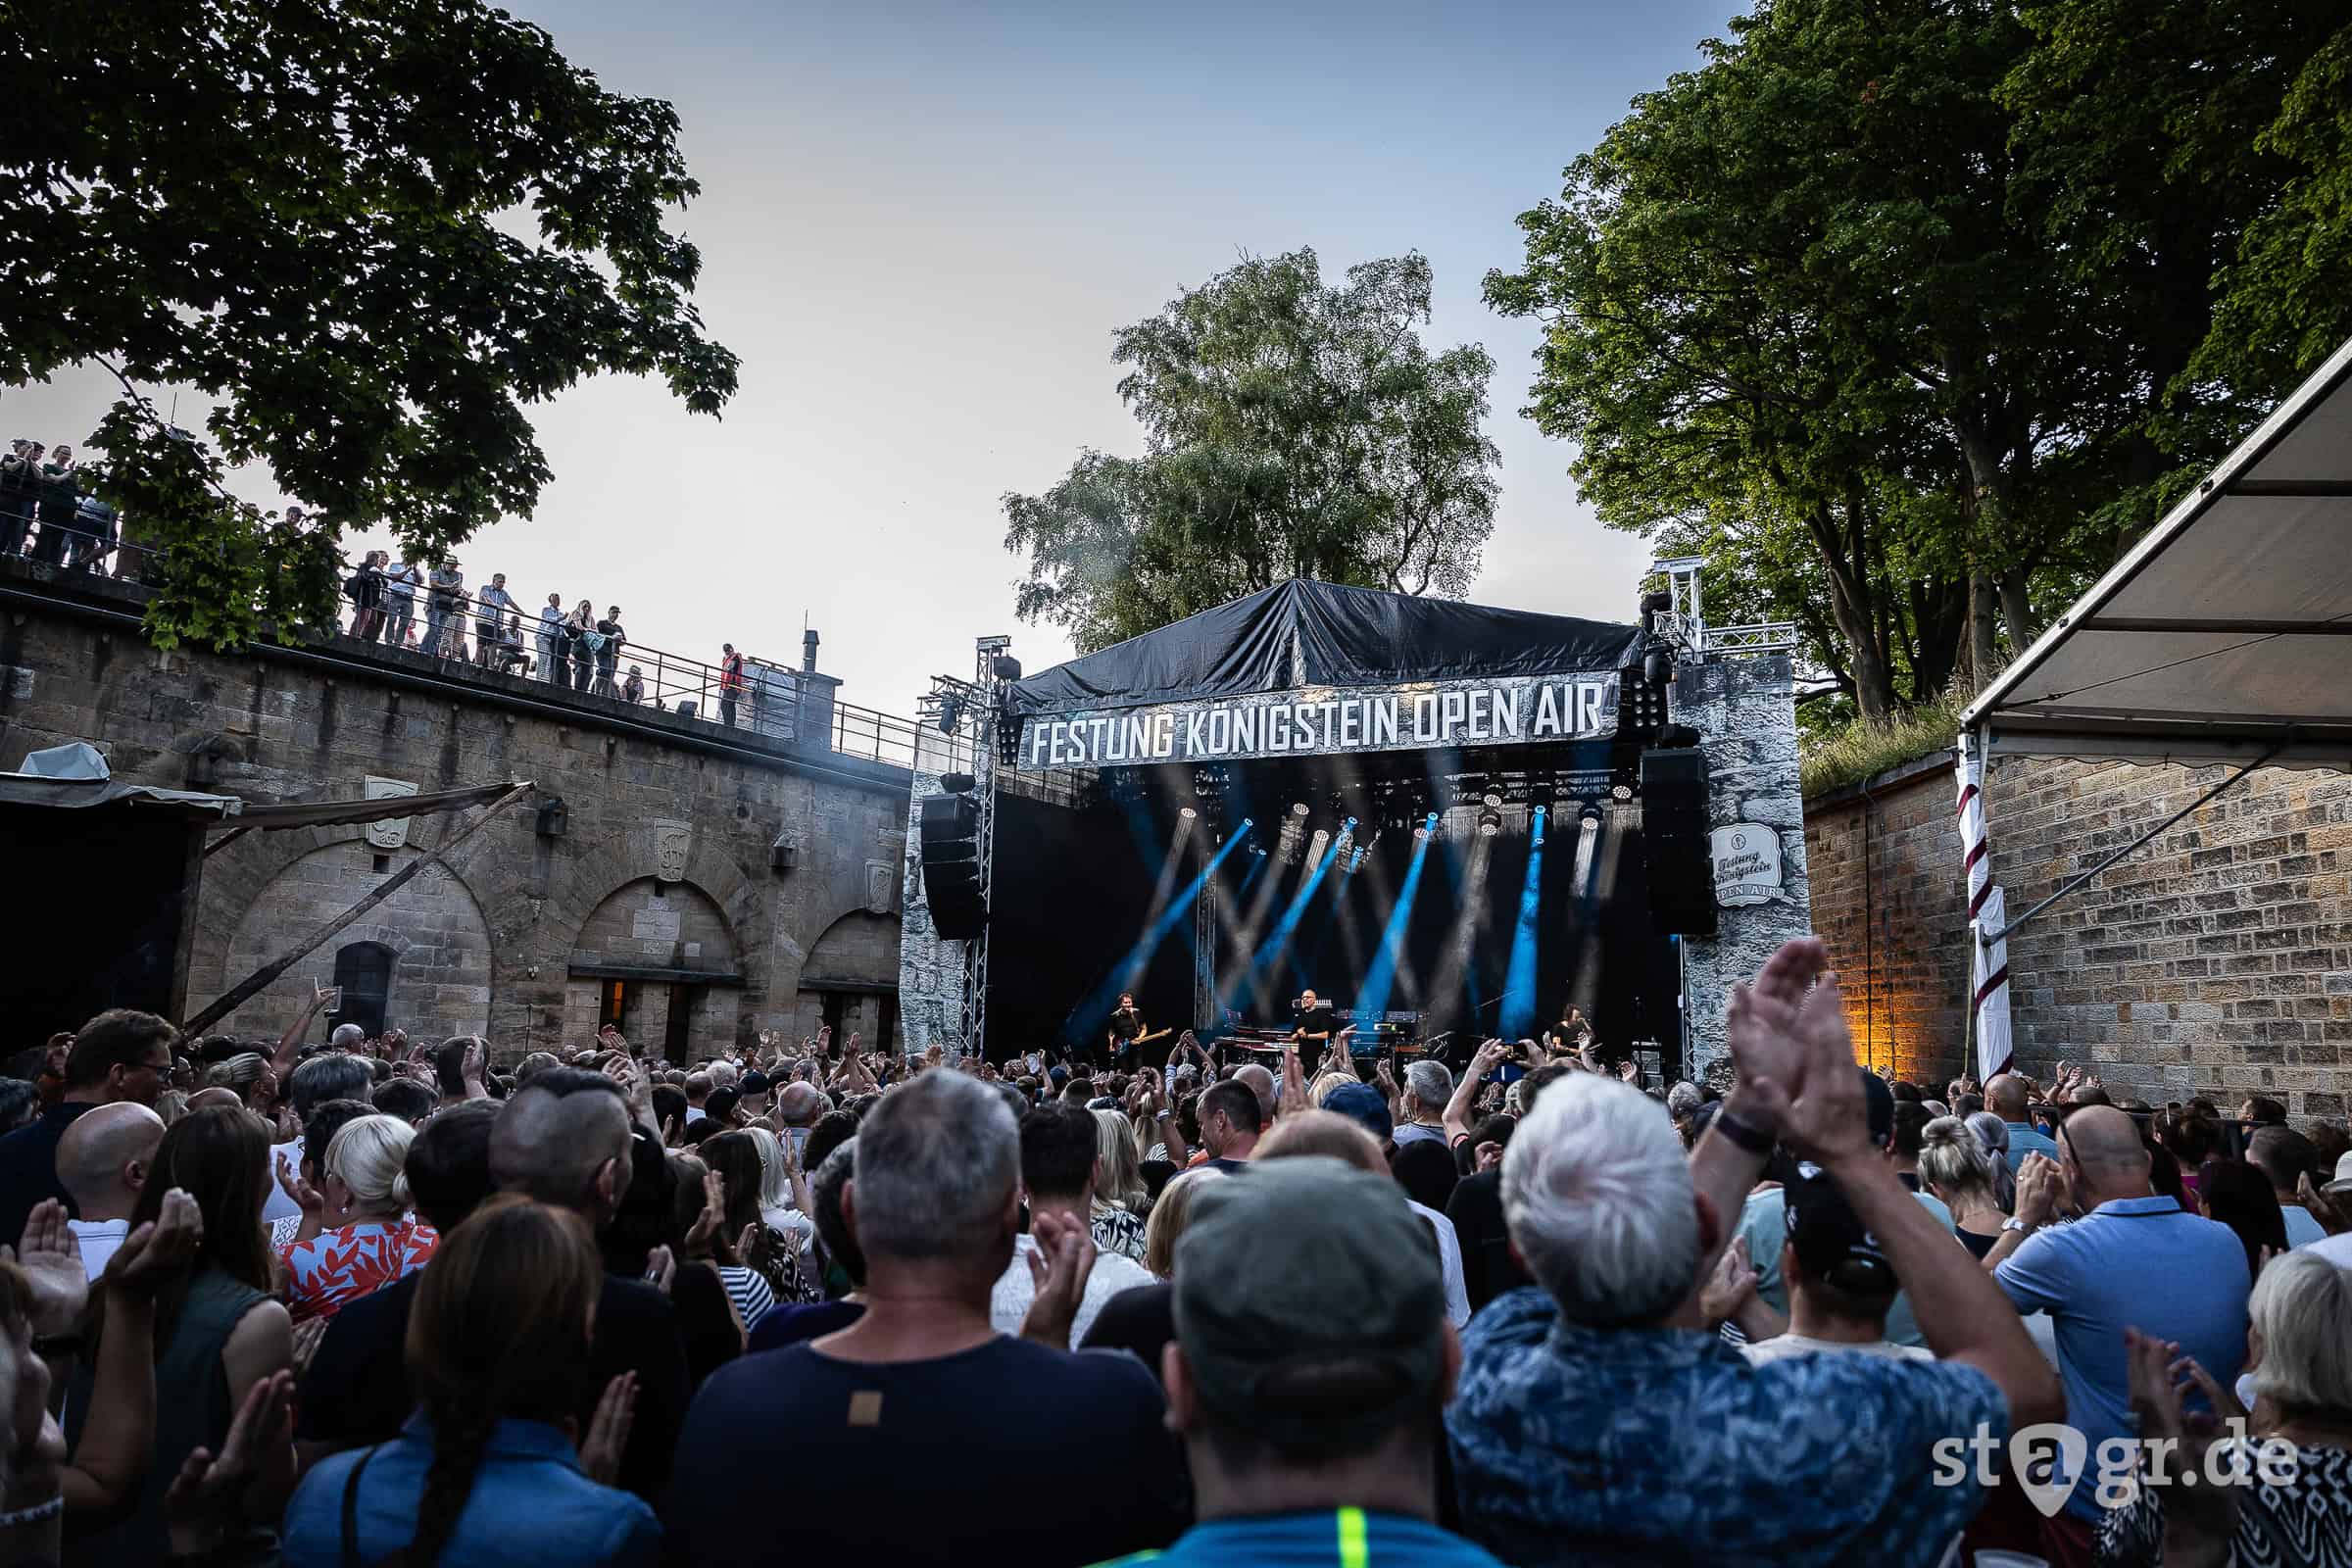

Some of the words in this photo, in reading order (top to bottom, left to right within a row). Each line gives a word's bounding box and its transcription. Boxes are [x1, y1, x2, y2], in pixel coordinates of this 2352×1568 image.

[1031, 712, 1175, 764] FESTUNG
[1186, 697, 1398, 756] KÖNIGSTEIN
[1413, 688, 1519, 743] OPEN
[1534, 682, 1603, 736] AIR
[1718, 852, 1760, 871] Festung
[1717, 885, 1743, 901] PEN
[1751, 885, 1776, 896] AIR
